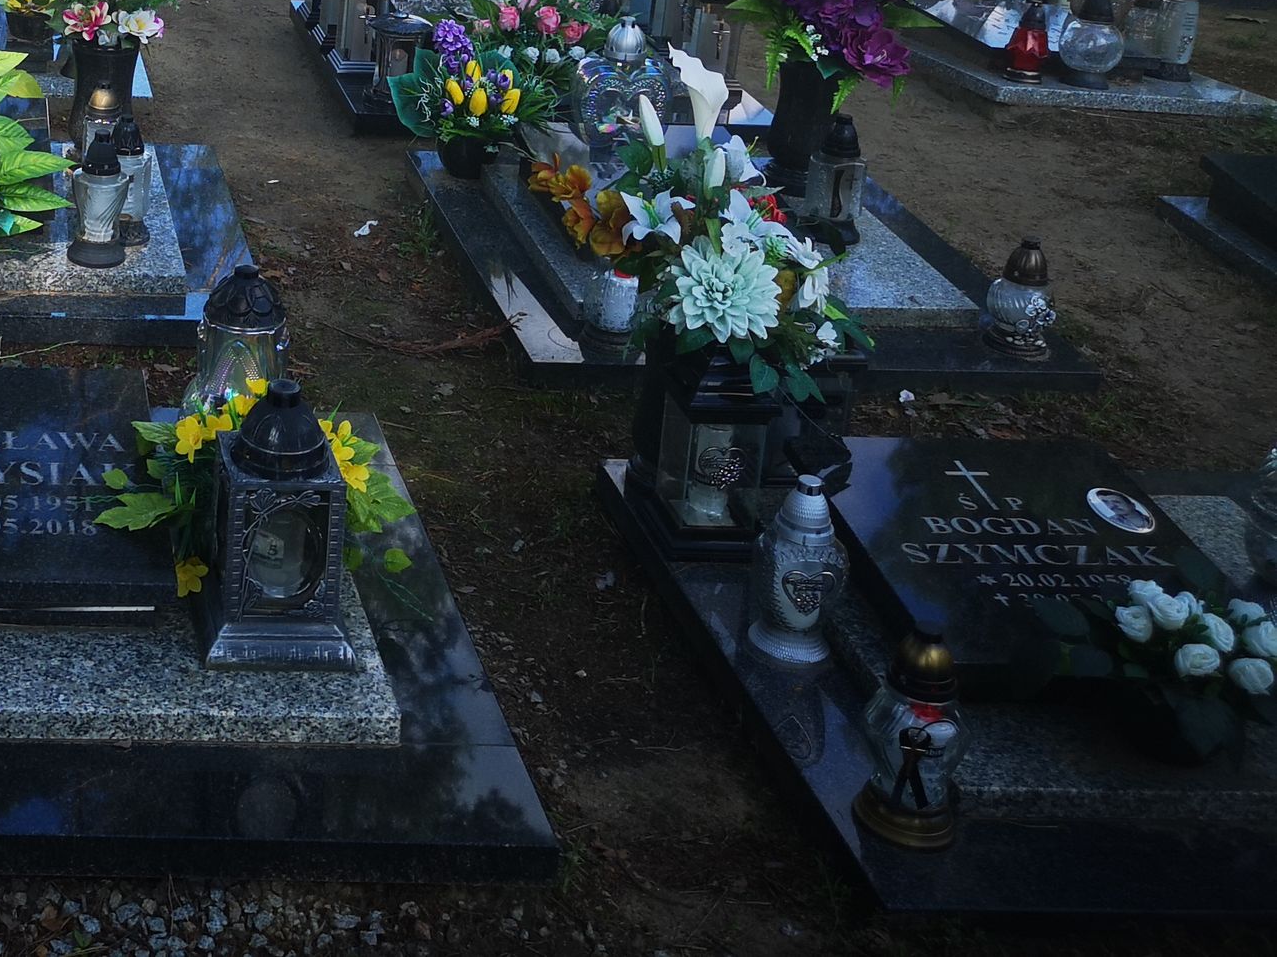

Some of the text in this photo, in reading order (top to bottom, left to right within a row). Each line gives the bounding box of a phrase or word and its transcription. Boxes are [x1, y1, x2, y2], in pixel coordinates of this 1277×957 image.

[1004, 497, 1024, 511] P
[920, 515, 1099, 537] BOGDAN
[900, 542, 1177, 568] SZYMCZAK
